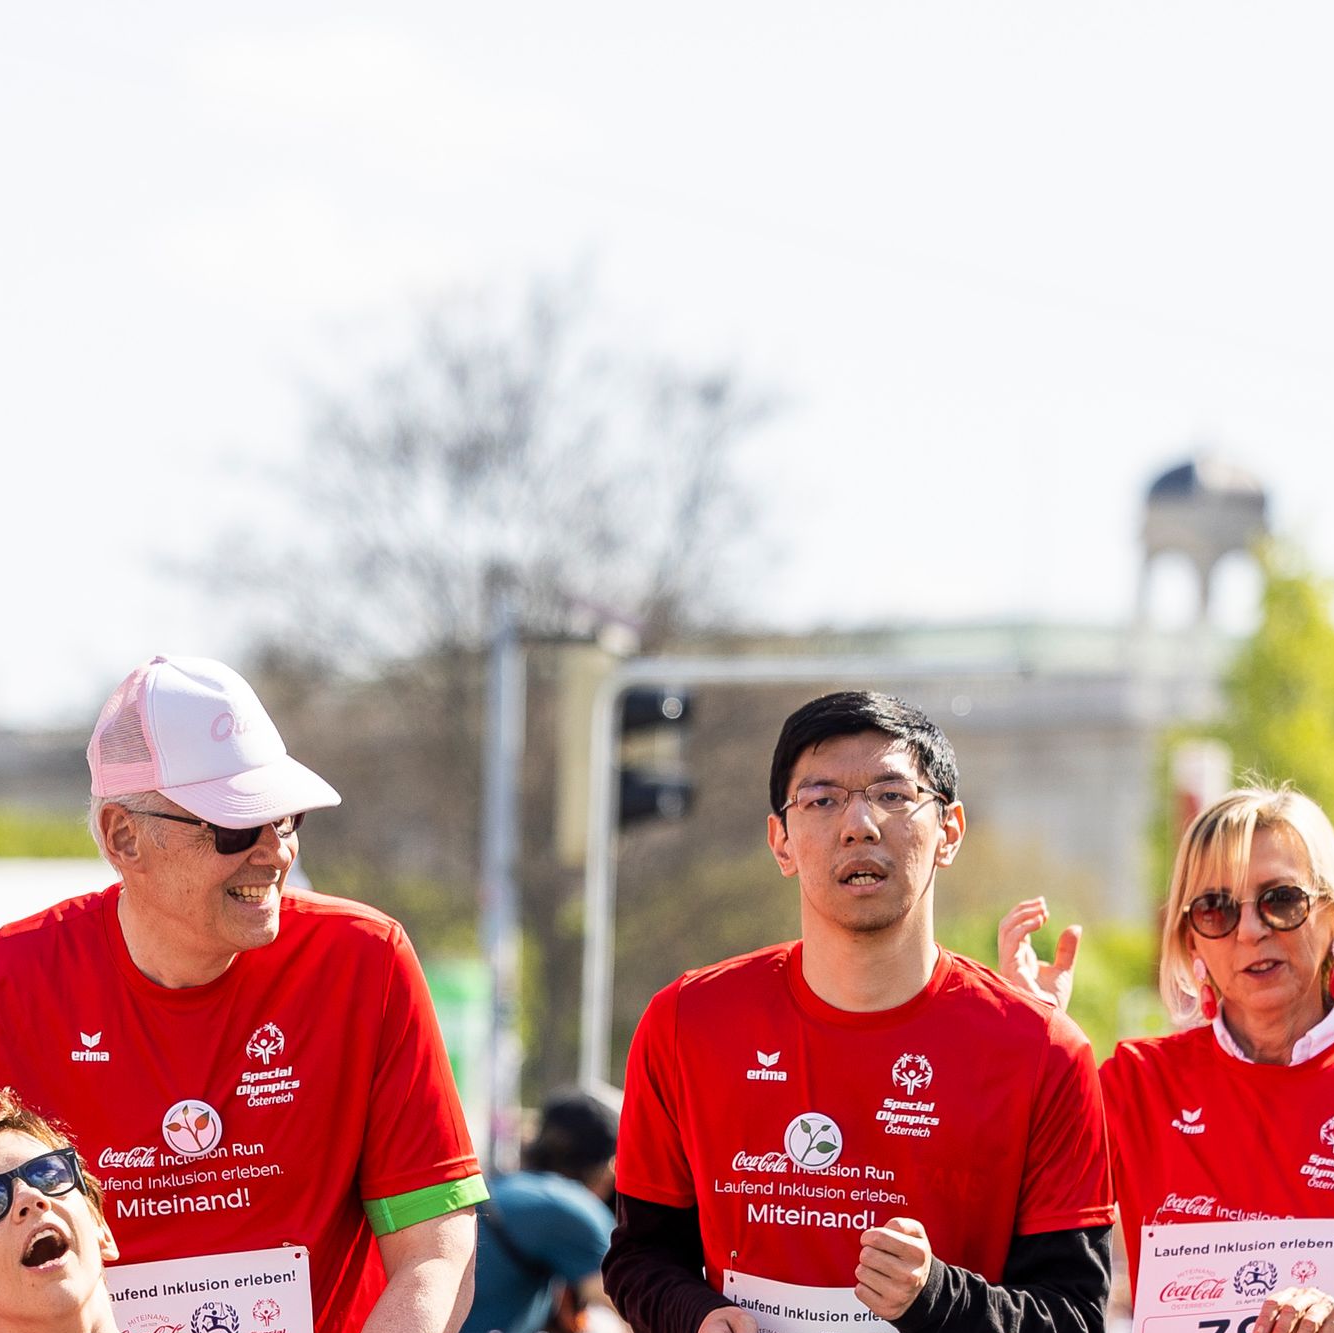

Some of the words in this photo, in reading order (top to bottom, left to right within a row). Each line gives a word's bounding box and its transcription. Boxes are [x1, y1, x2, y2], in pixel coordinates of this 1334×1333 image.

[71, 1050, 109, 1061] erima
[242, 1066, 292, 1083] Special
[747, 1068, 787, 1081] erima
[236, 1080, 300, 1096] Olympics
[247, 1091, 293, 1107] Österreich
[883, 1098, 935, 1113] Special
[875, 1111, 940, 1127] Olympics
[1171, 1119, 1205, 1135] erima
[884, 1123, 931, 1138] Österreich
[98, 1146, 158, 1169] Coca-Cola
[232, 1143, 264, 1157] Run
[100, 1177, 142, 1191] ufend
[148, 1170, 217, 1189] Inklusion
[221, 1163, 284, 1181] erleben.
[865, 1166, 895, 1181] Run
[715, 1179, 774, 1196] Laufend
[779, 1182, 845, 1200] Inklusion
[851, 1187, 908, 1206] erleben.
[117, 1187, 251, 1219] Miteinand!
[747, 1203, 876, 1230] Miteinand!
[1154, 1244, 1209, 1258] Laufend
[1215, 1241, 1275, 1254] Inklusion
[109, 1285, 157, 1302] aufend
[163, 1279, 229, 1296] Inklusion
[234, 1270, 296, 1288] erleben!
[1160, 1278, 1228, 1303] Coca-Cola
[1245, 1289, 1266, 1297] VCM
[785, 1307, 848, 1322] Inklusion
[854, 1310, 884, 1321] erle
